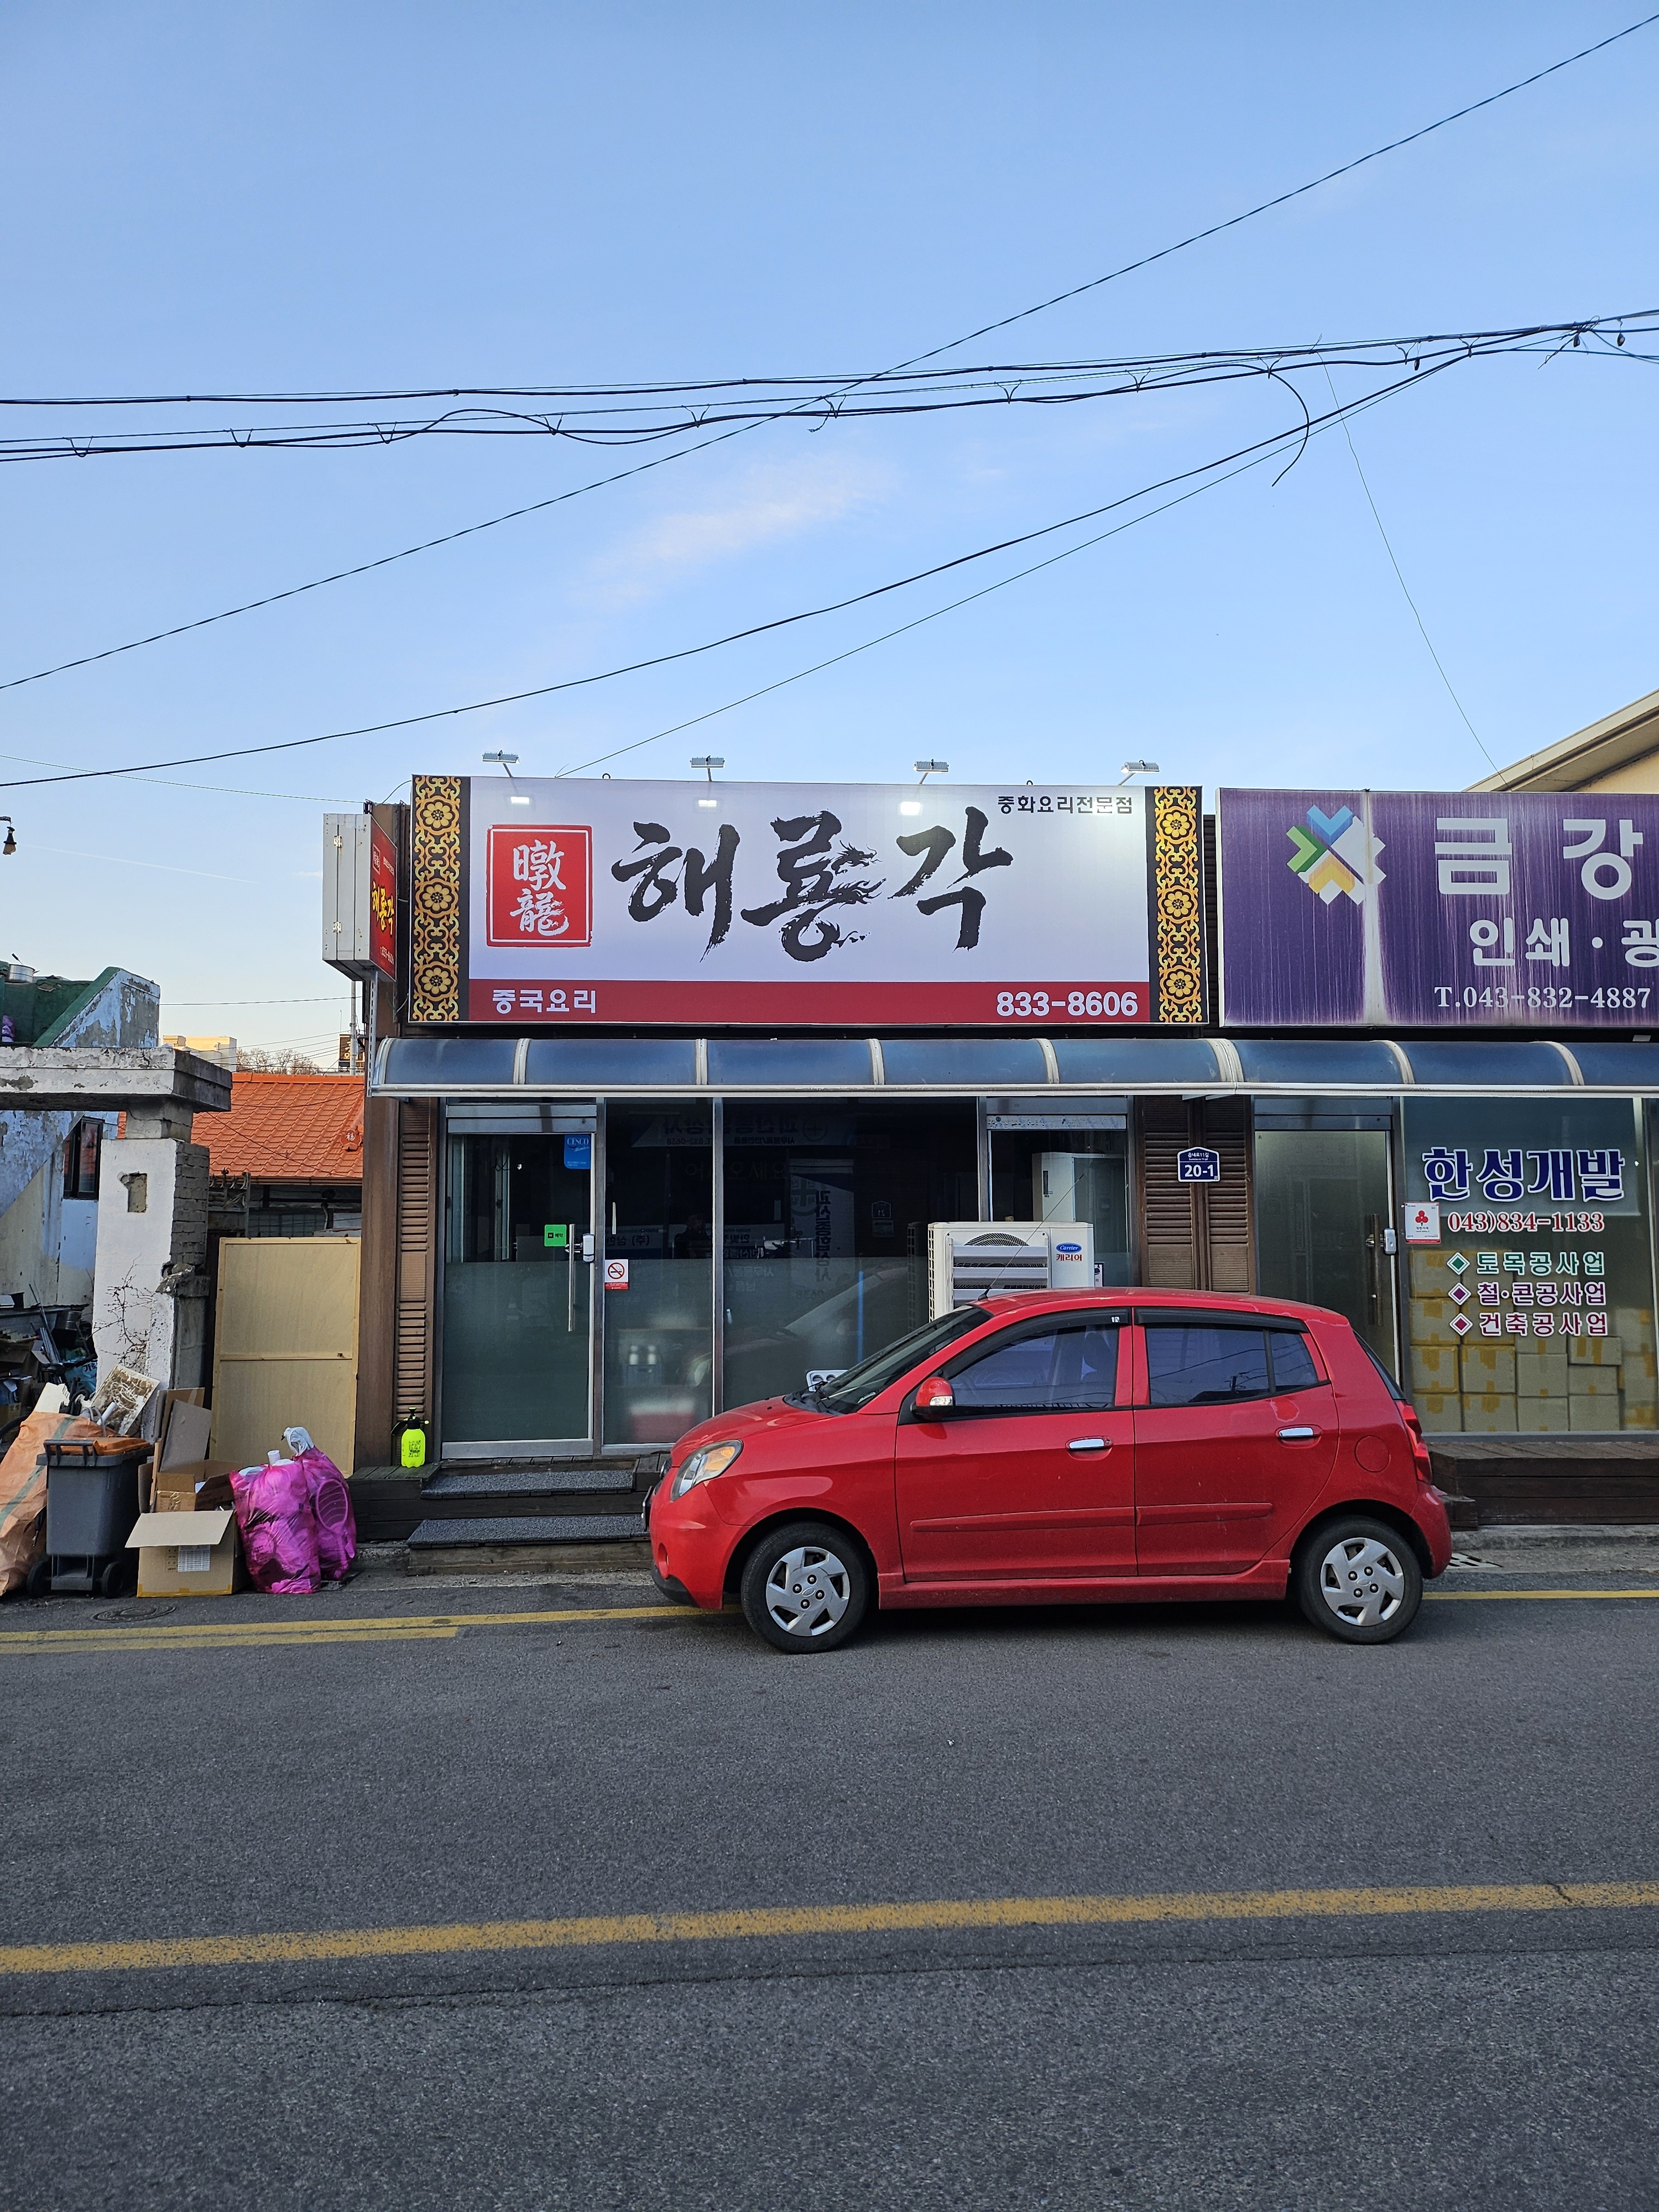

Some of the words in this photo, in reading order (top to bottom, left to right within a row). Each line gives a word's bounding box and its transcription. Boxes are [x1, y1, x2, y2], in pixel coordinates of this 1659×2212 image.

[998, 795, 1132, 814] 중화요리전문점
[611, 810, 1013, 962] 해룡각
[372, 879, 394, 936] 해룡각
[492, 989, 596, 1014] 중국요리
[997, 991, 1138, 1016] 833-8606
[1434, 986, 1651, 1008] T.043-832-4887
[567, 1137, 589, 1145] CESCO
[1185, 1164, 1214, 1177] 20-1
[1422, 1147, 1625, 1202] 한성개발
[1447, 1210, 1605, 1233] 043)834-1133
[1477, 1251, 1605, 1276] 토목공사업
[1479, 1312, 1608, 1336] 건축공사업
